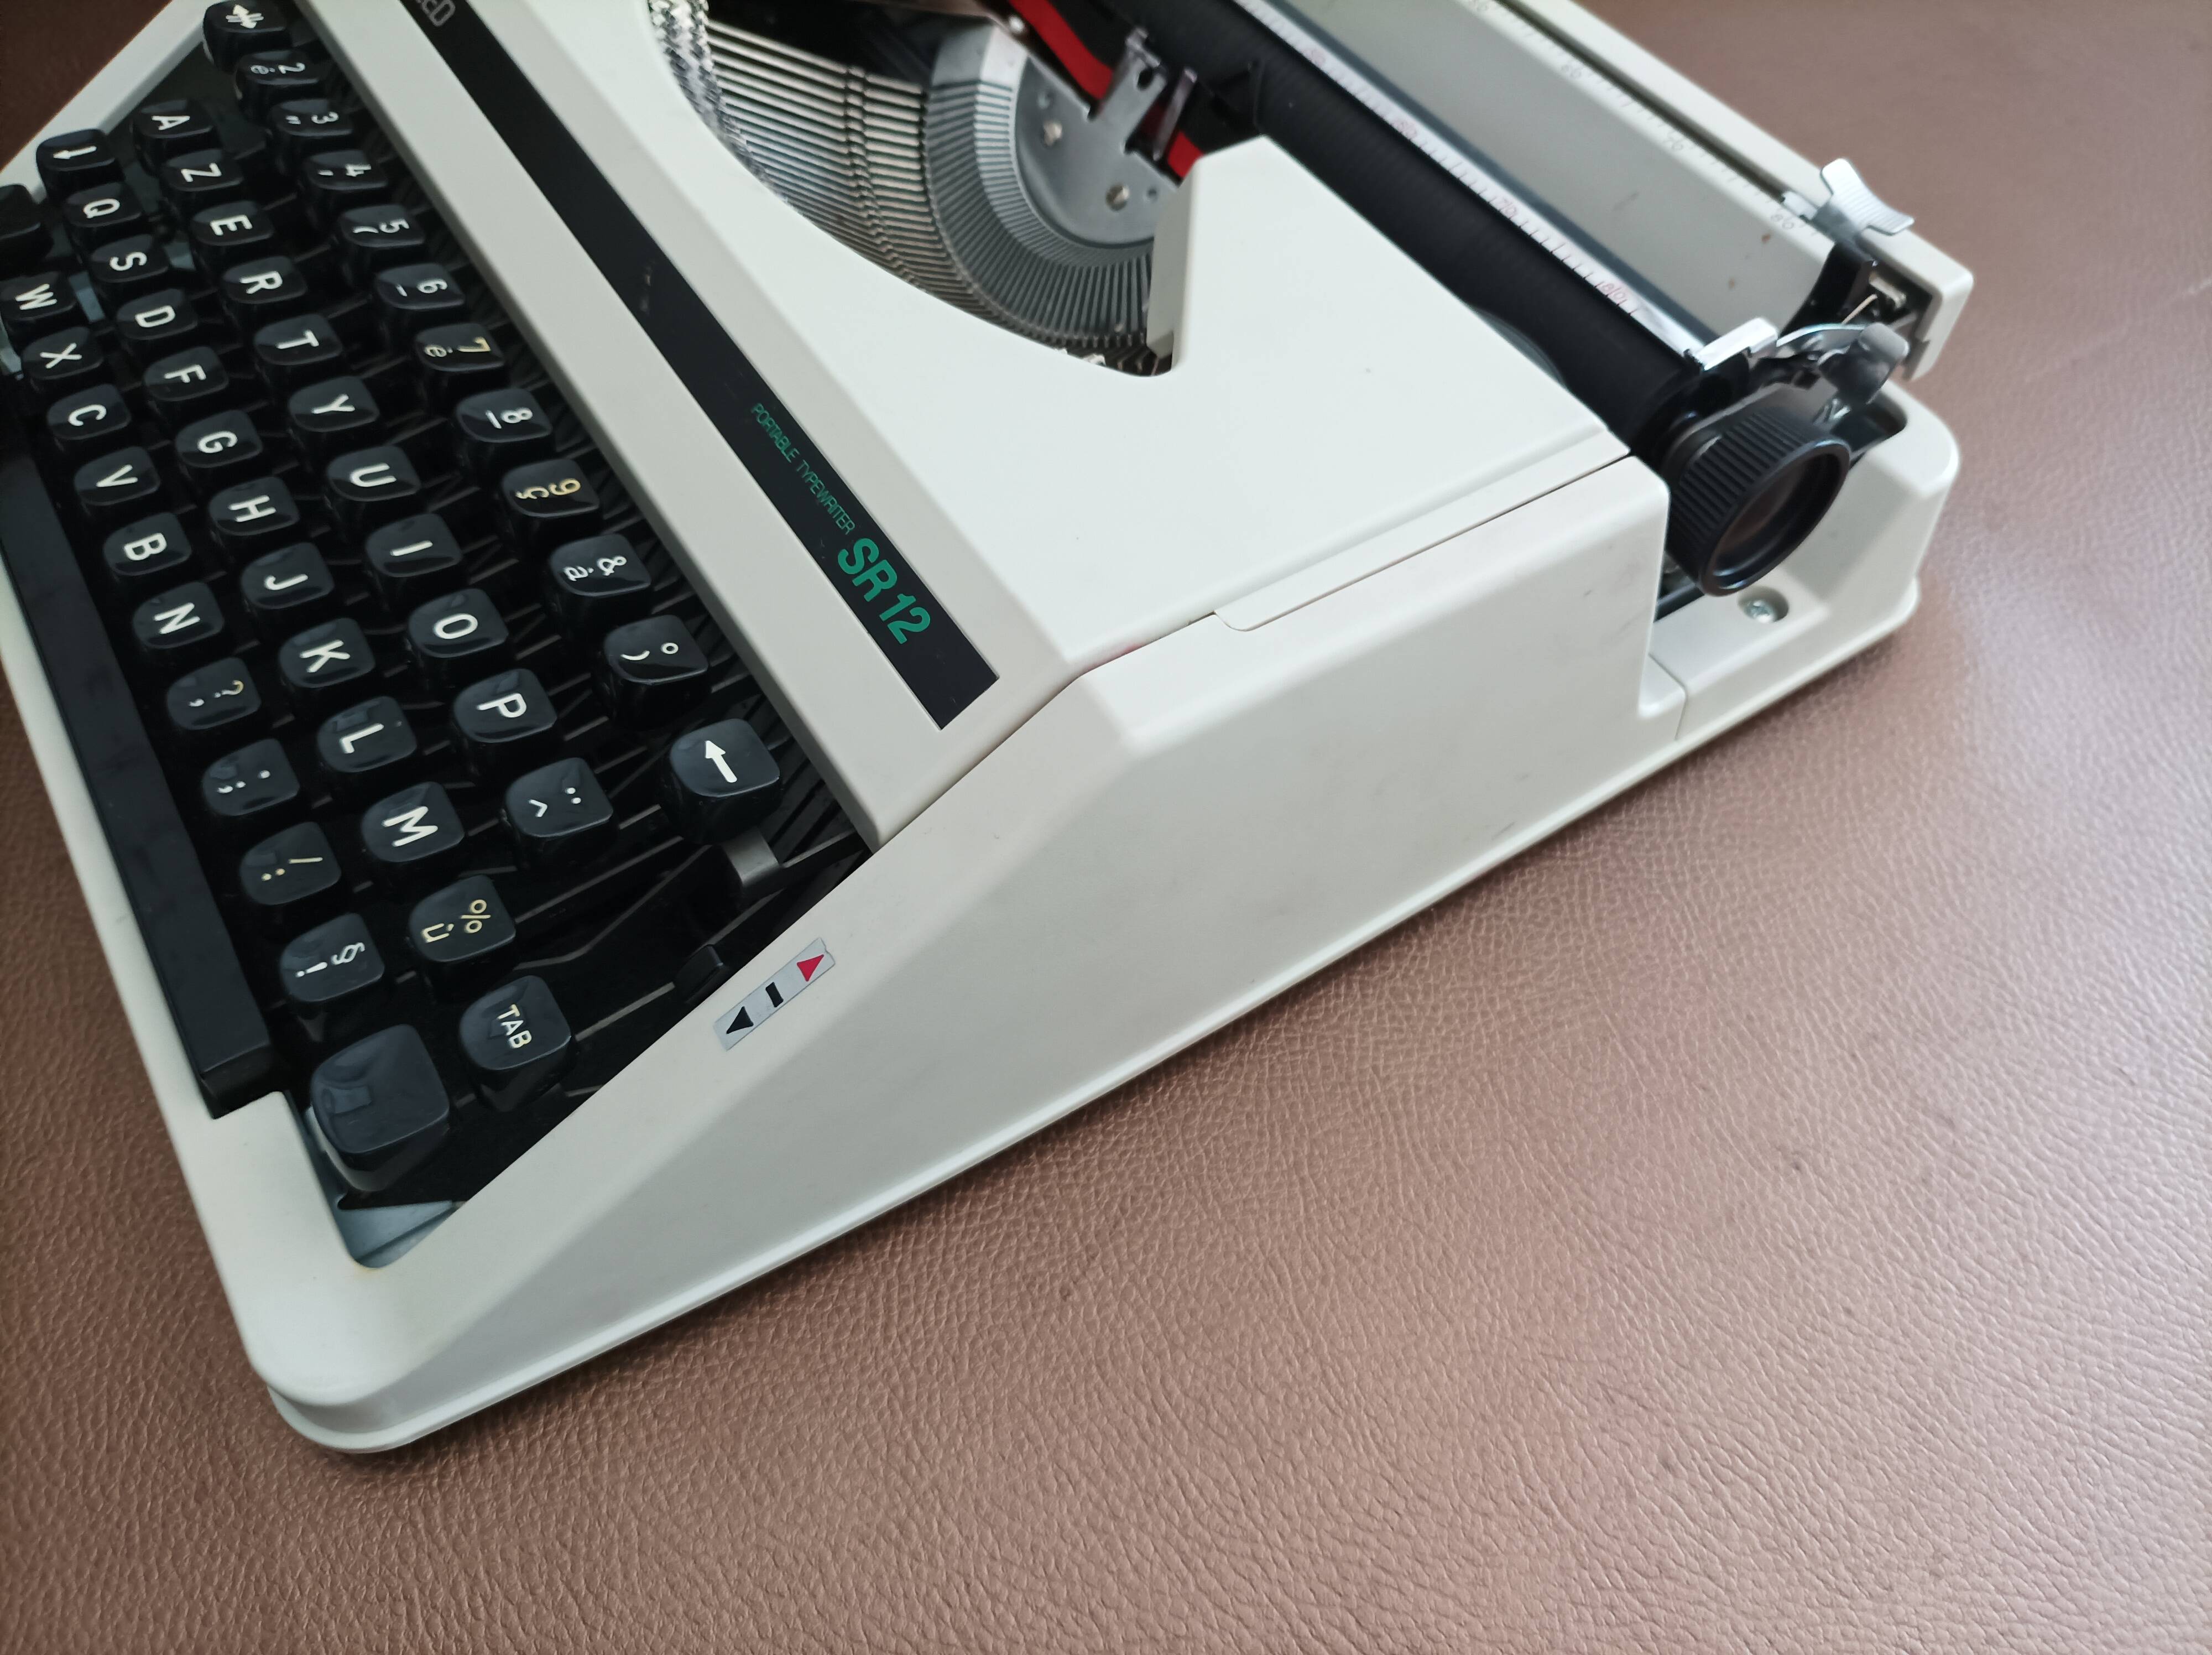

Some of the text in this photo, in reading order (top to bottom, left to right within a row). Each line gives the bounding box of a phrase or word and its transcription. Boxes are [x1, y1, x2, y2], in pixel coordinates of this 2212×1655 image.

[278, 63, 305, 74] 2
[152, 115, 190, 131] A
[311, 112, 338, 124] 3
[180, 163, 222, 183] Z
[345, 163, 372, 177] 4
[83, 198, 120, 218] Q
[210, 215, 253, 236] E
[379, 218, 409, 233] 5
[109, 252, 147, 271] S
[239, 270, 283, 294] R
[418, 279, 448, 294] 6
[1600, 282, 1627, 301] 80
[15, 283, 58, 310] W
[135, 305, 175, 328] D
[277, 330, 319, 349] T
[458, 337, 491, 352] 7
[39, 342, 82, 369] X
[164, 365, 206, 383] F
[311, 394, 355, 414] Y
[68, 404, 107, 426] C
[501, 408, 533, 424] 8
[197, 431, 237, 454] G
[96, 465, 138, 487] V
[349, 464, 397, 487] U
[751, 403, 855, 535] PORTABLE TYPEWRITER
[515, 487, 550, 499] ç
[549, 478, 581, 496] 9
[228, 495, 276, 522] H
[123, 533, 167, 561] B
[597, 556, 627, 576] &
[264, 574, 308, 591] J
[837, 538, 931, 644] SR 12
[154, 602, 200, 634] N
[434, 613, 478, 639] O
[300, 640, 351, 673] K
[215, 680, 244, 698] ?
[477, 693, 527, 718] P
[340, 724, 384, 754] L
[383, 806, 439, 847] M
[460, 899, 491, 934] %
[331, 942, 365, 965] §
[296, 962, 328, 977] !
[497, 1004, 532, 1048] TAB
